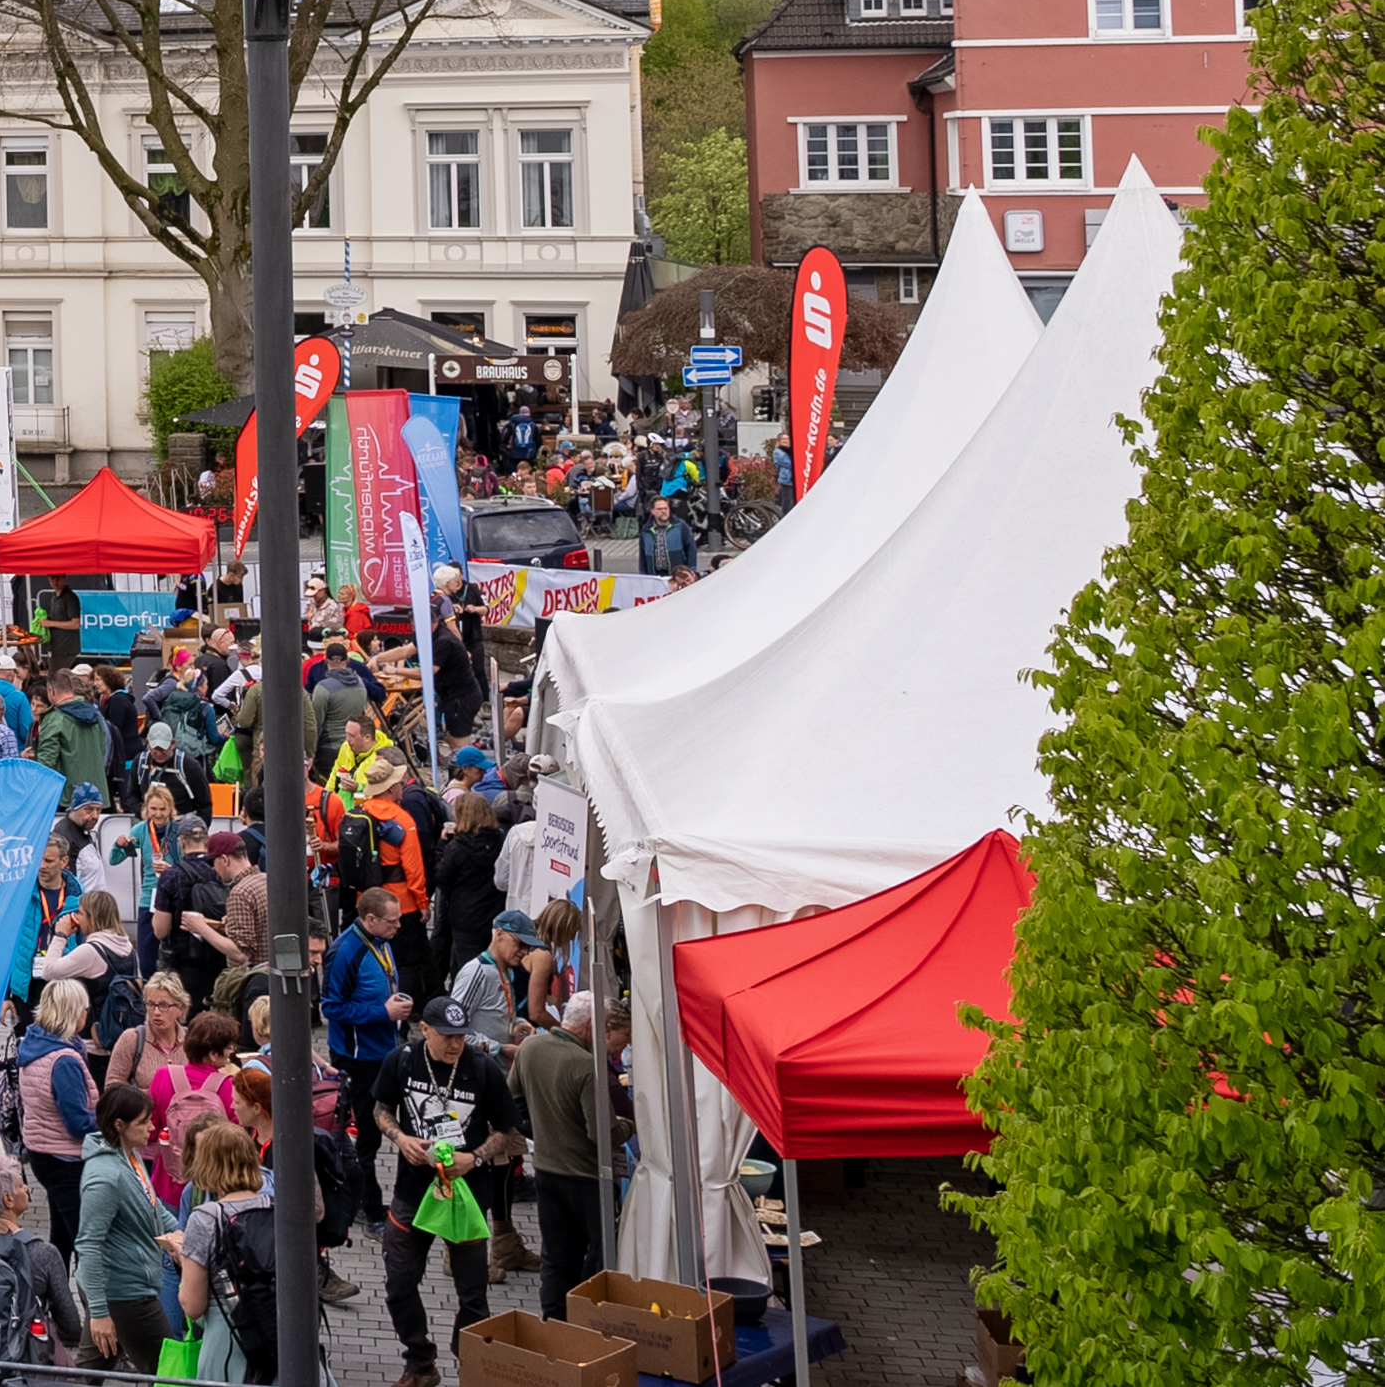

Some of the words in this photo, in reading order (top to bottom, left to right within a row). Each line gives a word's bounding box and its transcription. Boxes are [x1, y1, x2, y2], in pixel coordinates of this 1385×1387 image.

[351, 344, 424, 361] Warsteiner
[475, 365, 528, 380] BRAUHAUS
[476, 570, 514, 601] EXTRO
[541, 577, 598, 618] DEXTRO
[80, 611, 171, 630] ipperfür
